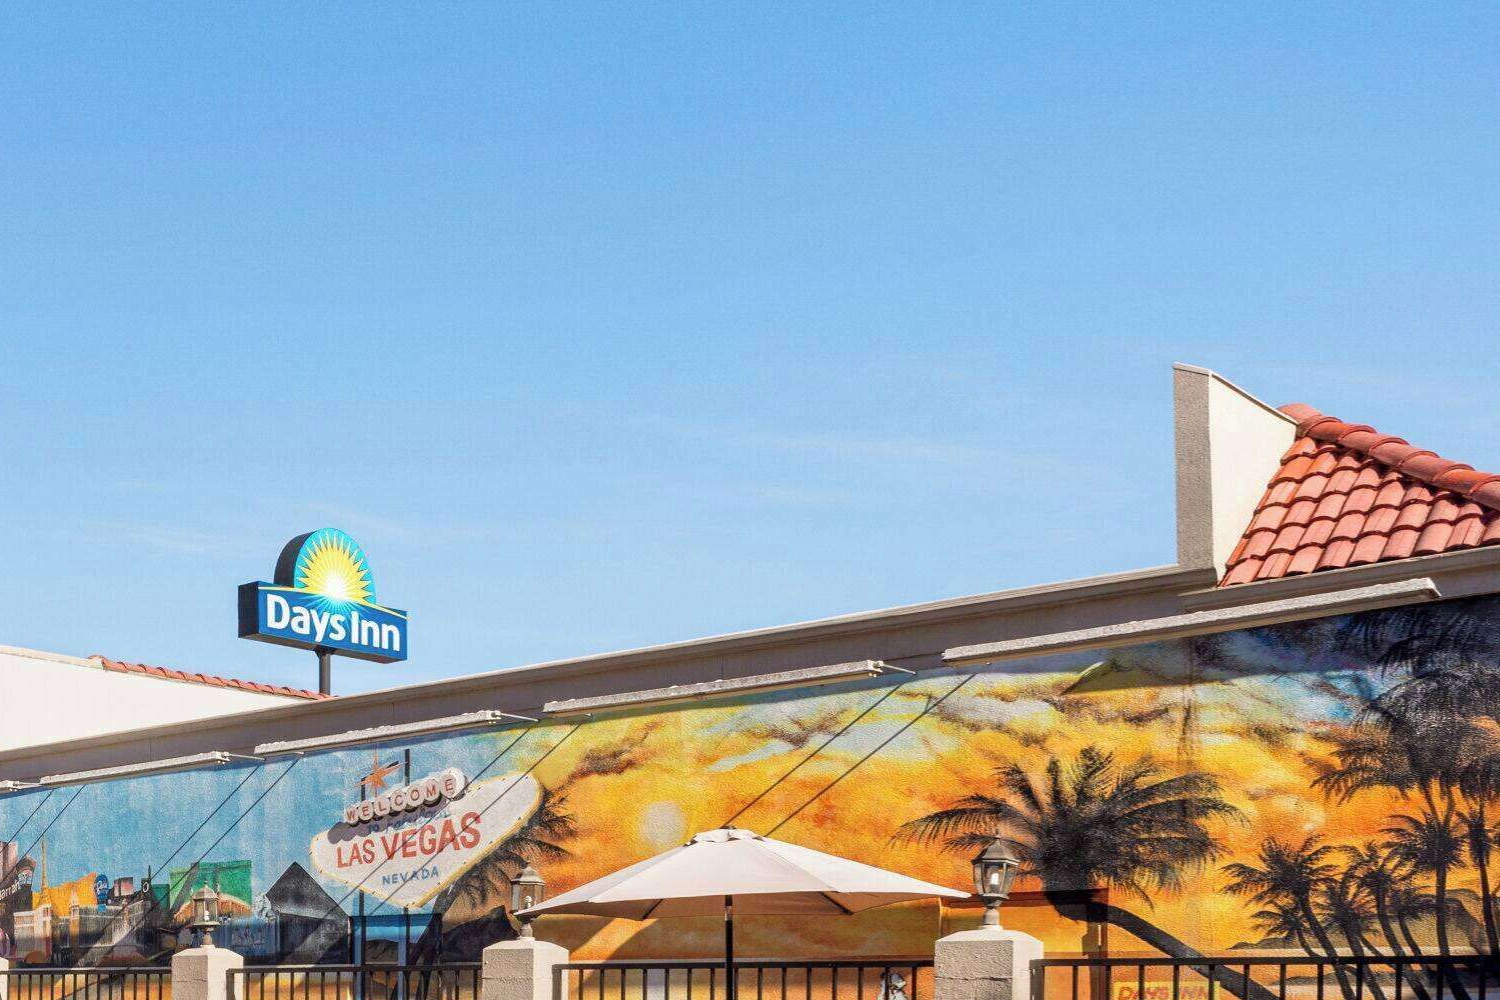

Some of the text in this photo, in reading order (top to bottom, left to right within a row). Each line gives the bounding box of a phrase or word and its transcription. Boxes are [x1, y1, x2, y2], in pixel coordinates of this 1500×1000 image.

[266, 594, 400, 651] Days Inn
[347, 777, 454, 821] WELCOME
[336, 839, 375, 868] LAS
[381, 812, 481, 860] VEGAS
[382, 866, 439, 885] NEVADA
